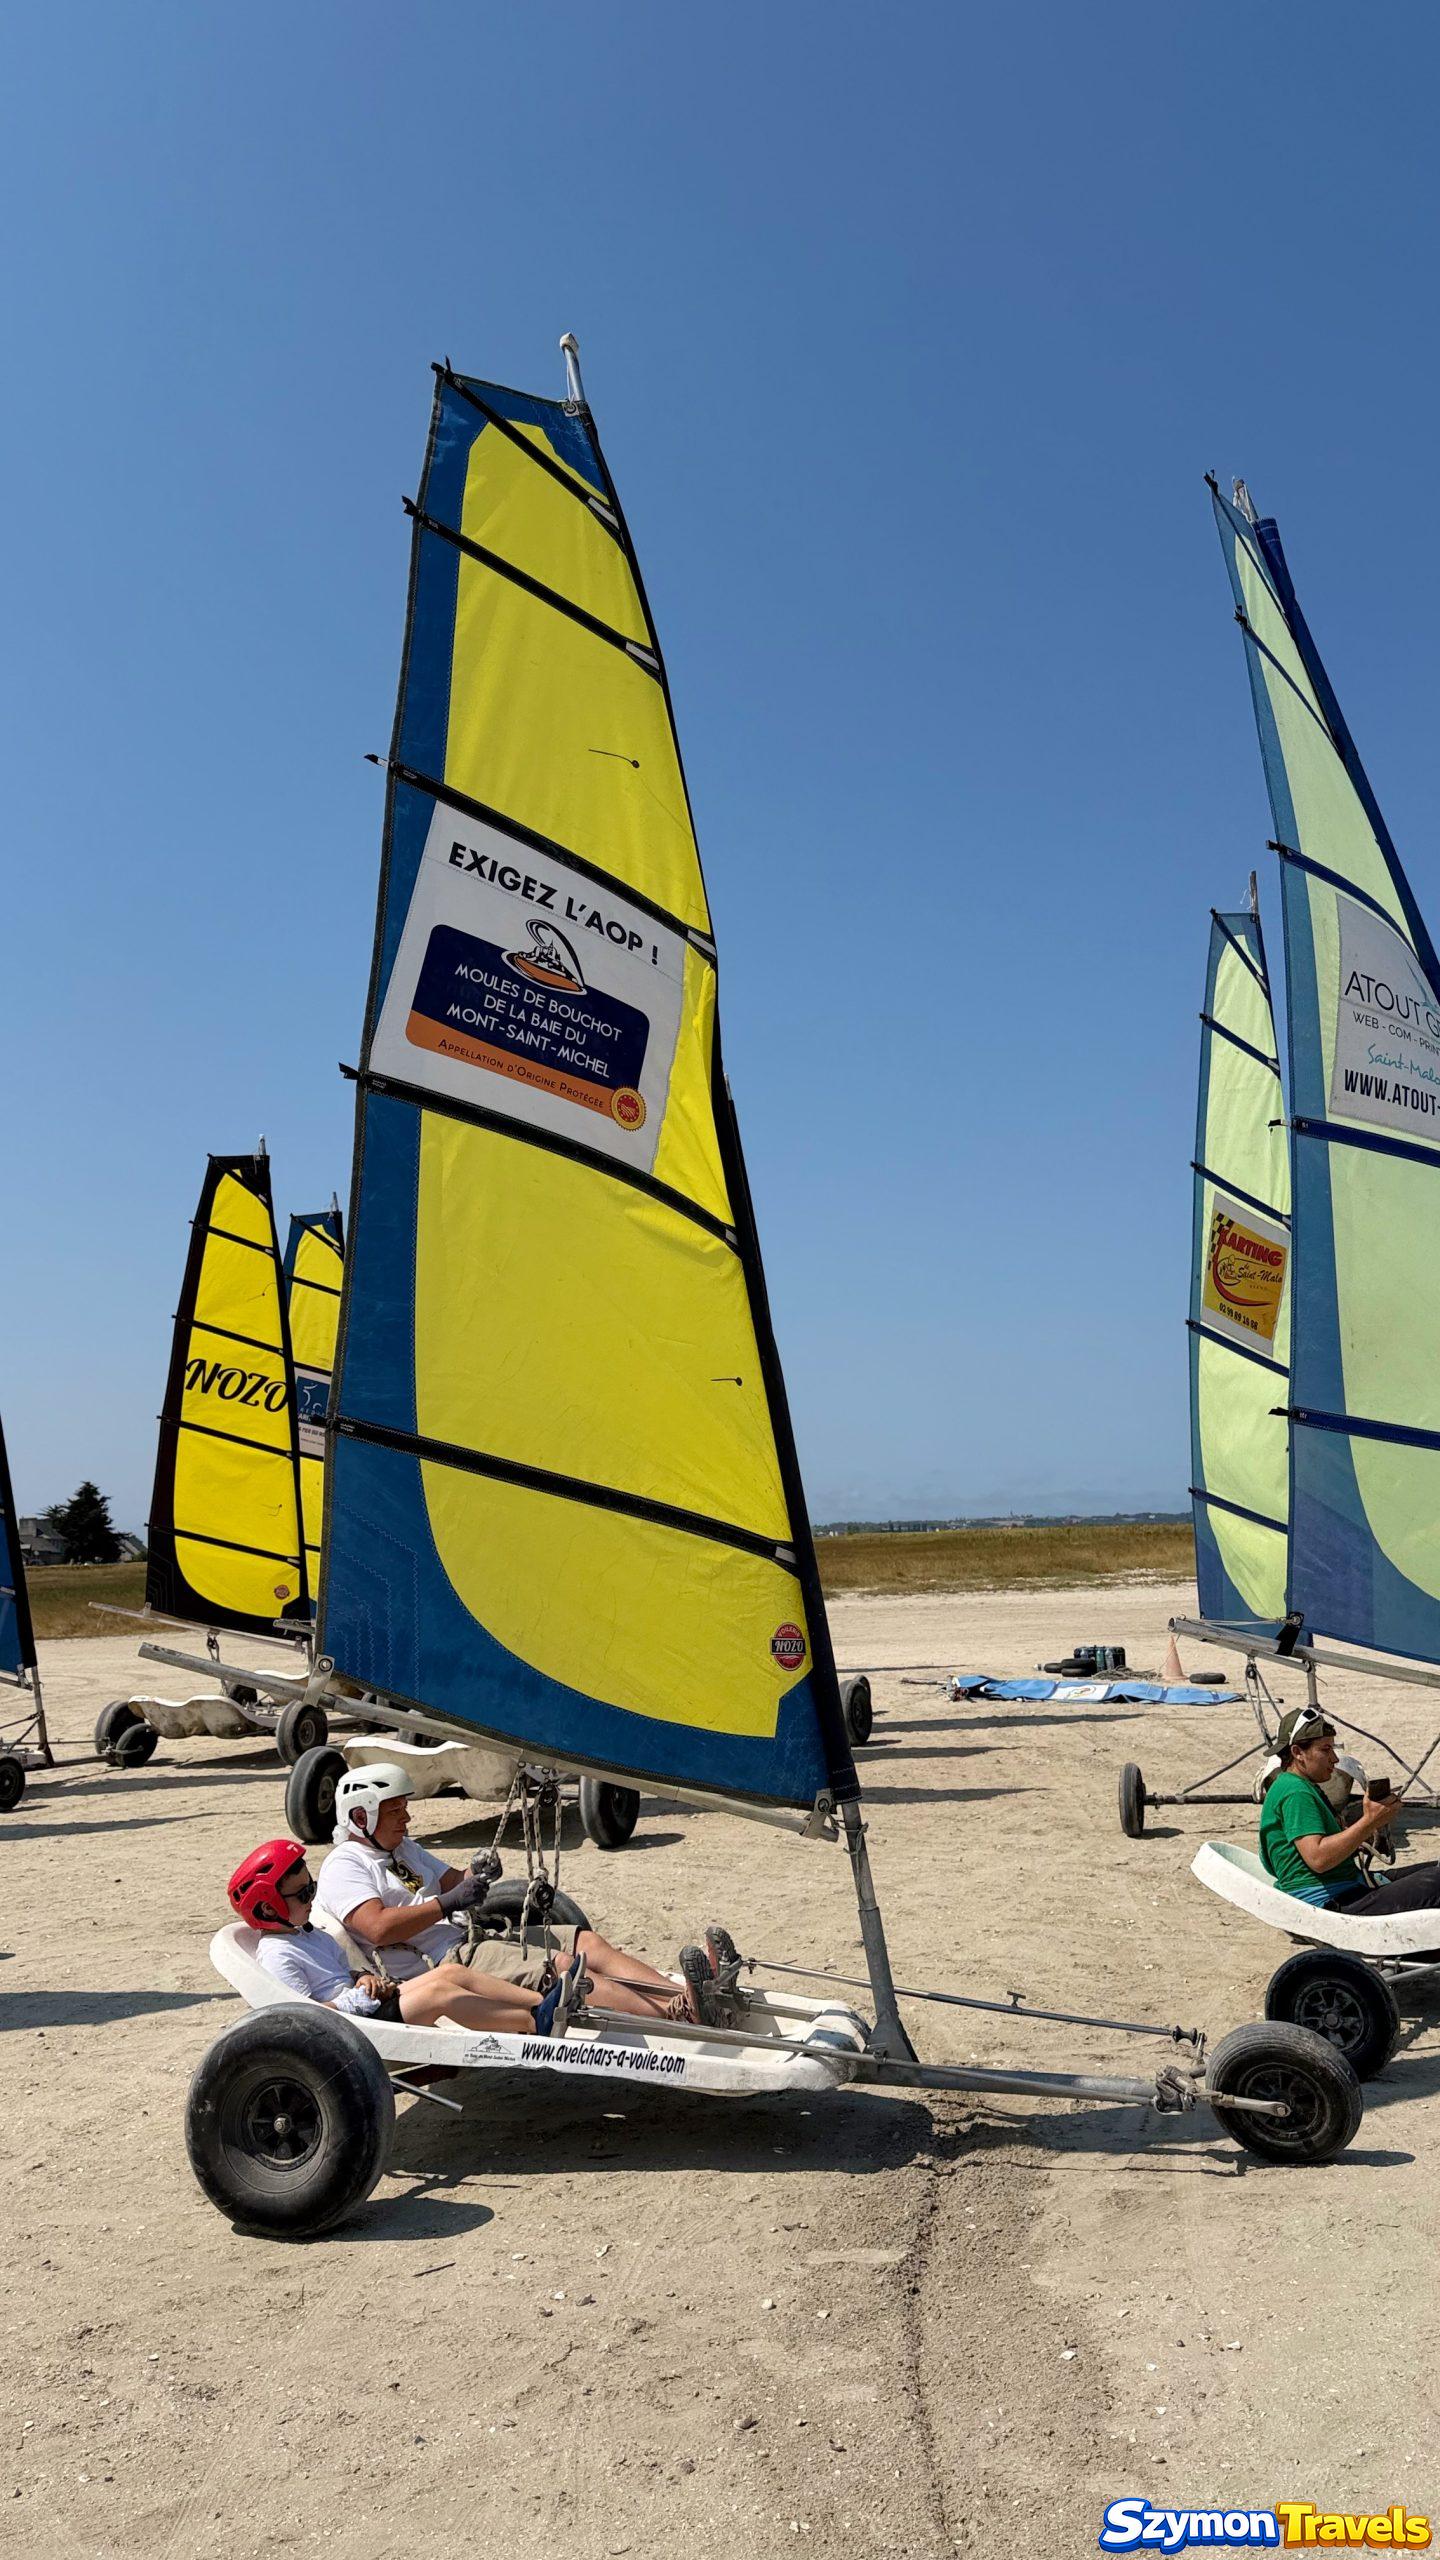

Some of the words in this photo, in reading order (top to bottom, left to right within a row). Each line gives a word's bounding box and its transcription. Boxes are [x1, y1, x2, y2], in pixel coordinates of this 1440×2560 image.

[448, 841, 558, 910] EXIGEZ
[565, 896, 643, 951] L'AOP
[651, 945, 658, 966] !
[455, 963, 520, 997] MOULES
[524, 989, 546, 1008] DE
[549, 1000, 622, 1042] BOUCHOT
[484, 994, 506, 1014] DE
[509, 1004, 526, 1022] LA
[531, 1014, 562, 1036] BAIE
[565, 1027, 587, 1046] DU
[1344, 971, 1421, 1026] ATOUT
[1353, 1010, 1379, 1029] WEB
[1389, 1024, 1412, 1042] COM
[1367, 1043, 1440, 1086] Saint-Malo
[1218, 1226, 1283, 1267] KARTING
[185, 1358, 288, 1412] NOZO
[774, 1640, 804, 1652] NOZO
[520, 2041, 686, 2074] www.avelchars-a-voile.com
